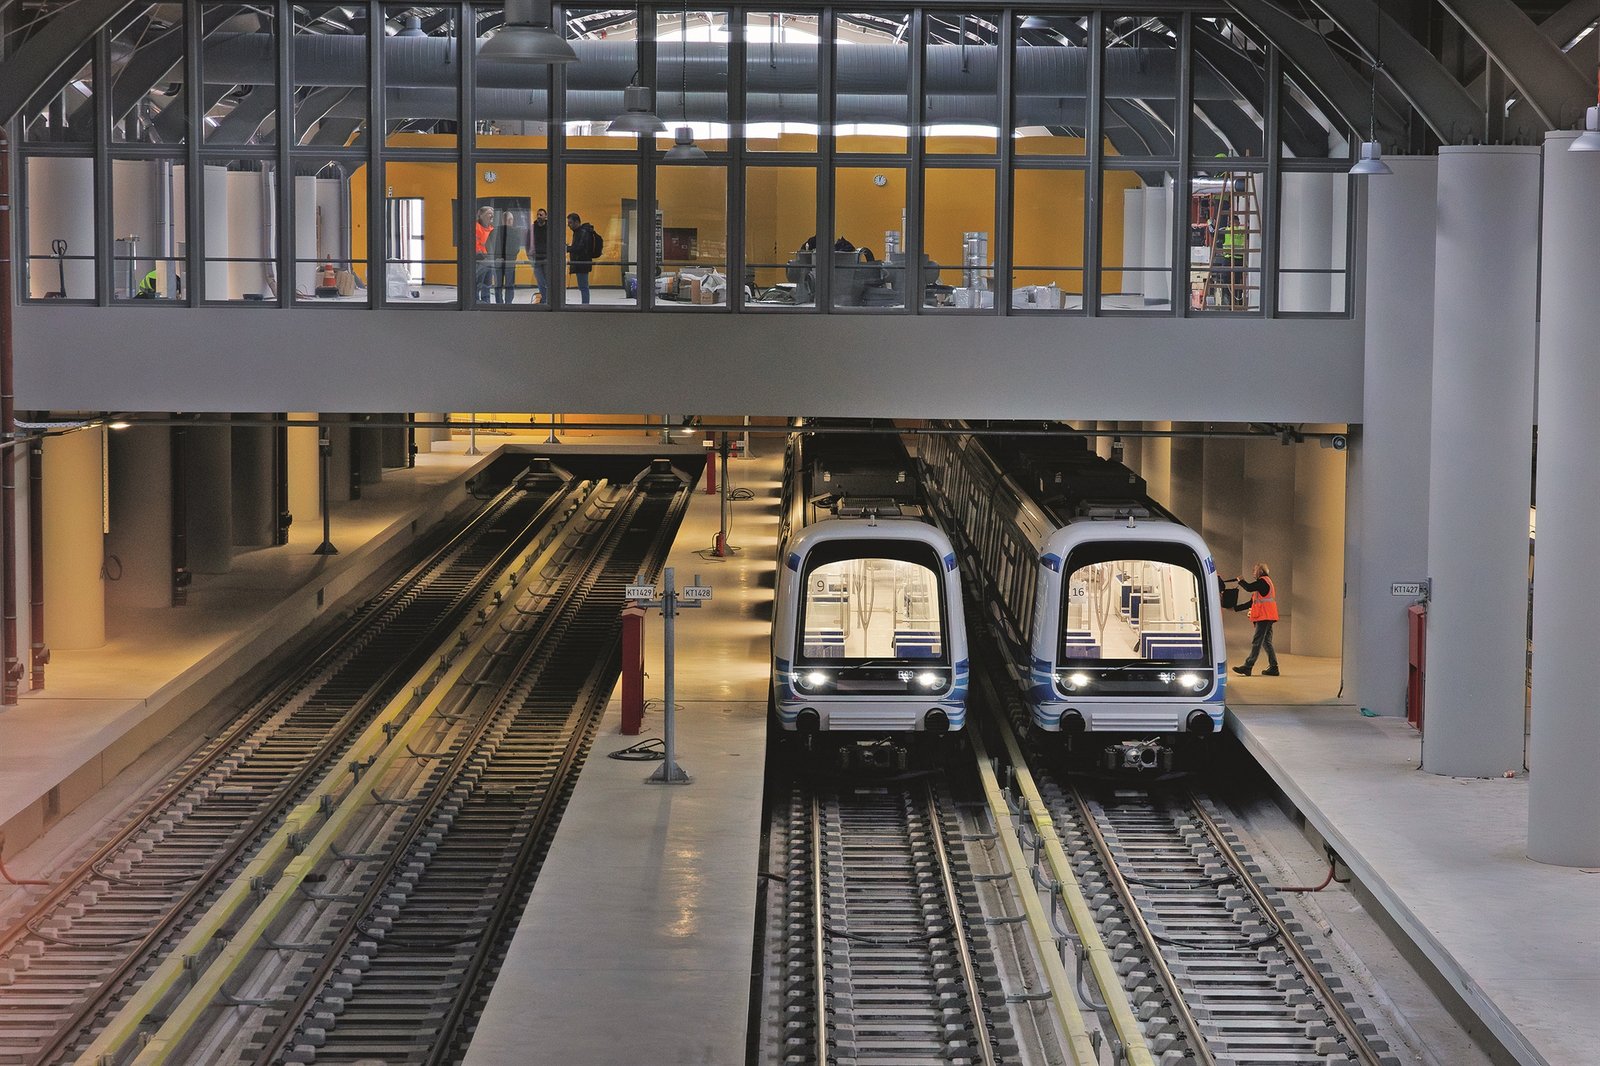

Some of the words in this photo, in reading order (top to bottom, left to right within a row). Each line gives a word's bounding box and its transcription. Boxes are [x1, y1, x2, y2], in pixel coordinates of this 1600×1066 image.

[816, 580, 825, 592] 9
[627, 589, 652, 597] KT1429
[685, 589, 711, 597] KT1428
[1072, 587, 1085, 597] 16
